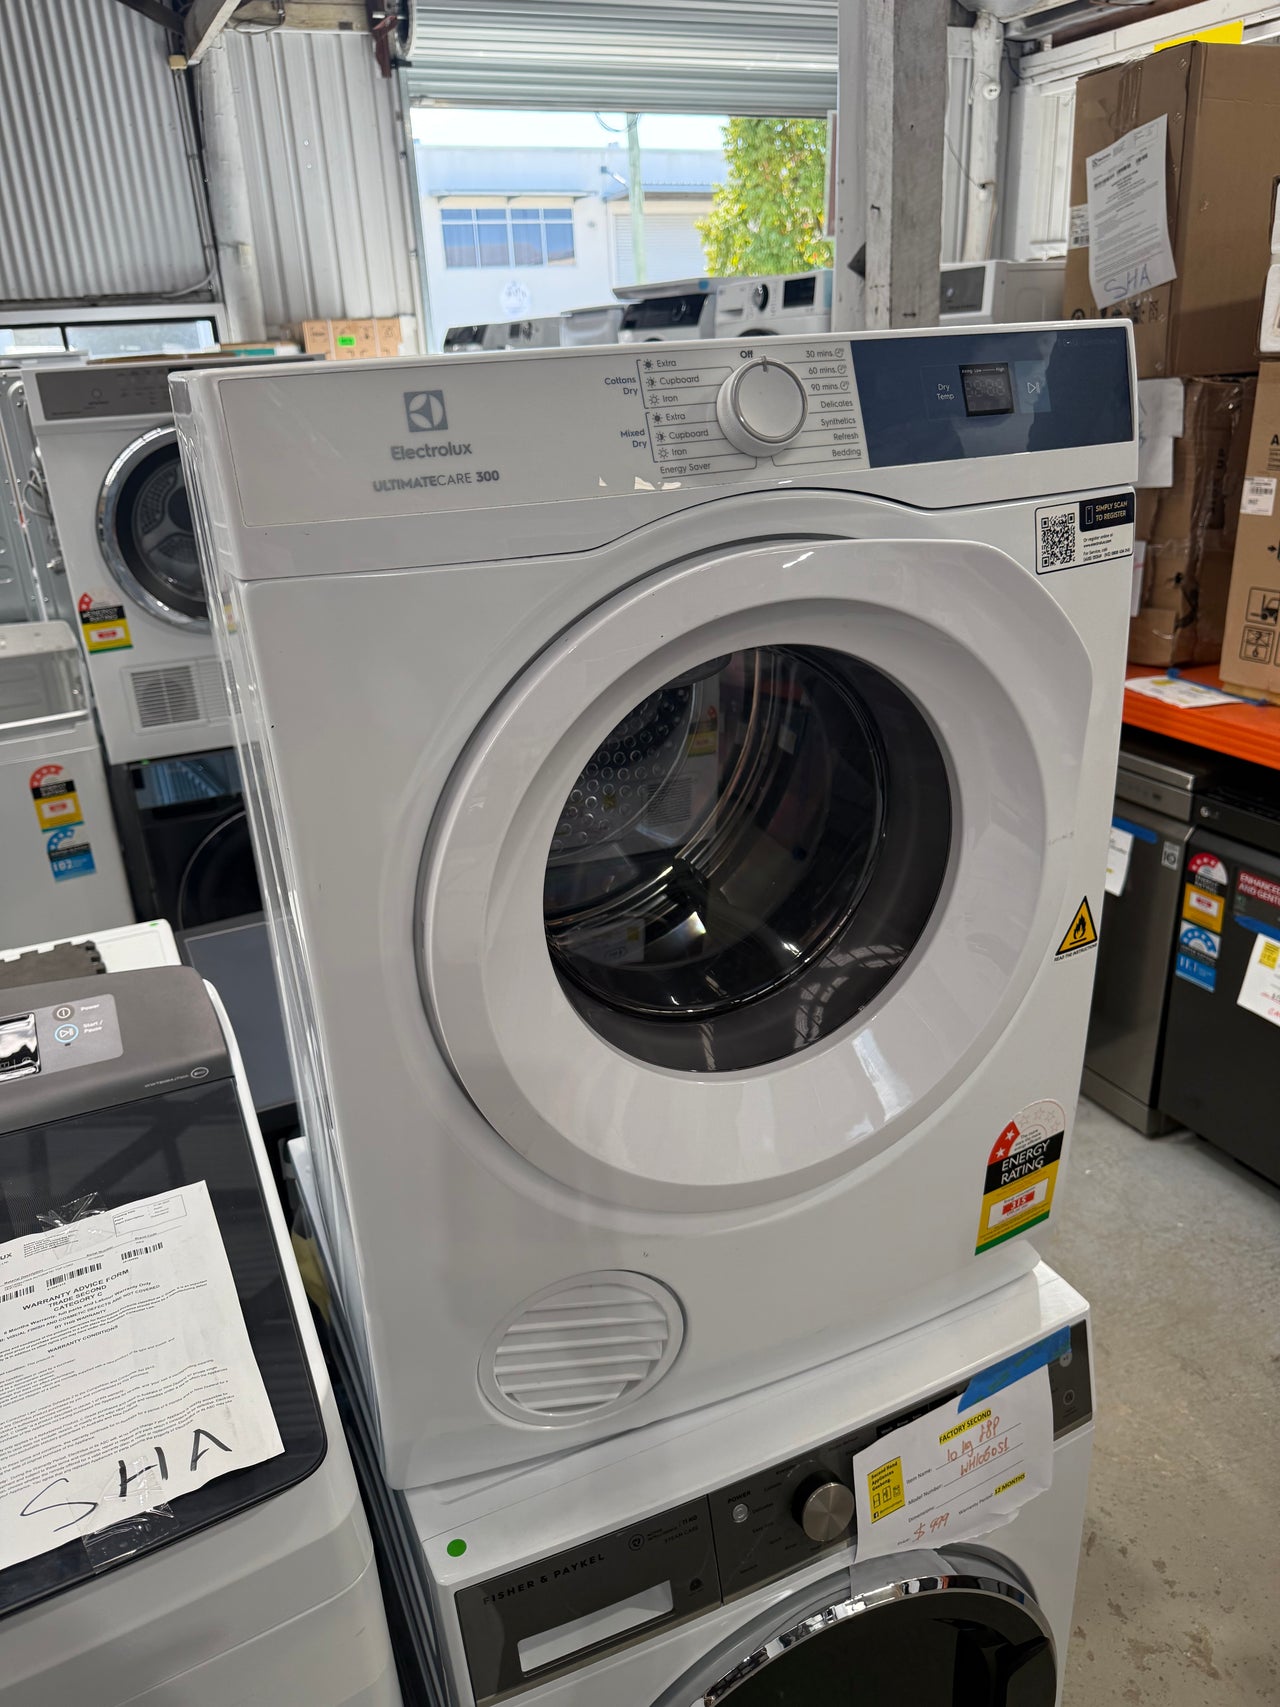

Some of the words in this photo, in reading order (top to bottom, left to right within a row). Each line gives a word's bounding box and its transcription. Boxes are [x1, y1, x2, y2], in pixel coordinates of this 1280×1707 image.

[1103, 263, 1152, 299] SHA
[740, 350, 753, 359] Off
[805, 350, 816, 359] 30
[656, 359, 677, 368] Extra
[808, 366, 818, 375] 60
[604, 375, 637, 386] Cottons
[659, 375, 700, 387] Cupboard
[623, 386, 639, 397] Dry
[810, 383, 821, 392] 90
[937, 383, 950, 392] Dry
[662, 394, 679, 403] Iron
[936, 393, 955, 401] Temp
[820, 399, 854, 409] Delicates
[665, 412, 686, 421] Extra
[820, 416, 857, 427] Synthetics
[620, 428, 646, 439] Mixed
[668, 428, 710, 440] Cupboard
[833, 432, 860, 441] Refresh
[632, 439, 648, 450] Dry
[390, 441, 473, 461] Electrolux
[671, 447, 688, 457] Iron
[831, 448, 862, 459] Bedding
[660, 464, 687, 475] Energy
[688, 462, 711, 472] Saver
[372, 472, 472, 493] ULTIMATECARE
[475, 470, 500, 483] 300
[1096, 503, 1114, 512] SIMPLY
[1114, 500, 1128, 509] SCAN
[1104, 510, 1126, 520] REGISTER
[1002, 1140, 1050, 1172] ENERGY
[1001, 1156, 1044, 1185] RATING
[22, 1290, 71, 1310] WARRANTY
[73, 1280, 104, 1294] ADVICE
[105, 1269, 129, 1284] FORM
[48, 1296, 74, 1308] TRADE
[76, 1284, 107, 1300] SECOND
[54, 1295, 95, 1312] CATEGORY
[48, 1338, 81, 1353] WARRANTY
[82, 1325, 118, 1341] CONDITIONS
[939, 1422, 966, 1444] FACTORY
[966, 1409, 992, 1428] SECOND
[871, 1468, 886, 1479] Second
[886, 1461, 898, 1470] Hand
[19, 1428, 233, 1533] SHA
[872, 1470, 894, 1486] Appliances
[994, 1486, 1001, 1495] 12
[1002, 1472, 1026, 1490] MONTHS
[728, 1490, 751, 1503] POWER
[482, 1580, 535, 1605] FISHER
[540, 1575, 548, 1584] &
[554, 1553, 605, 1578] PAYKEL
